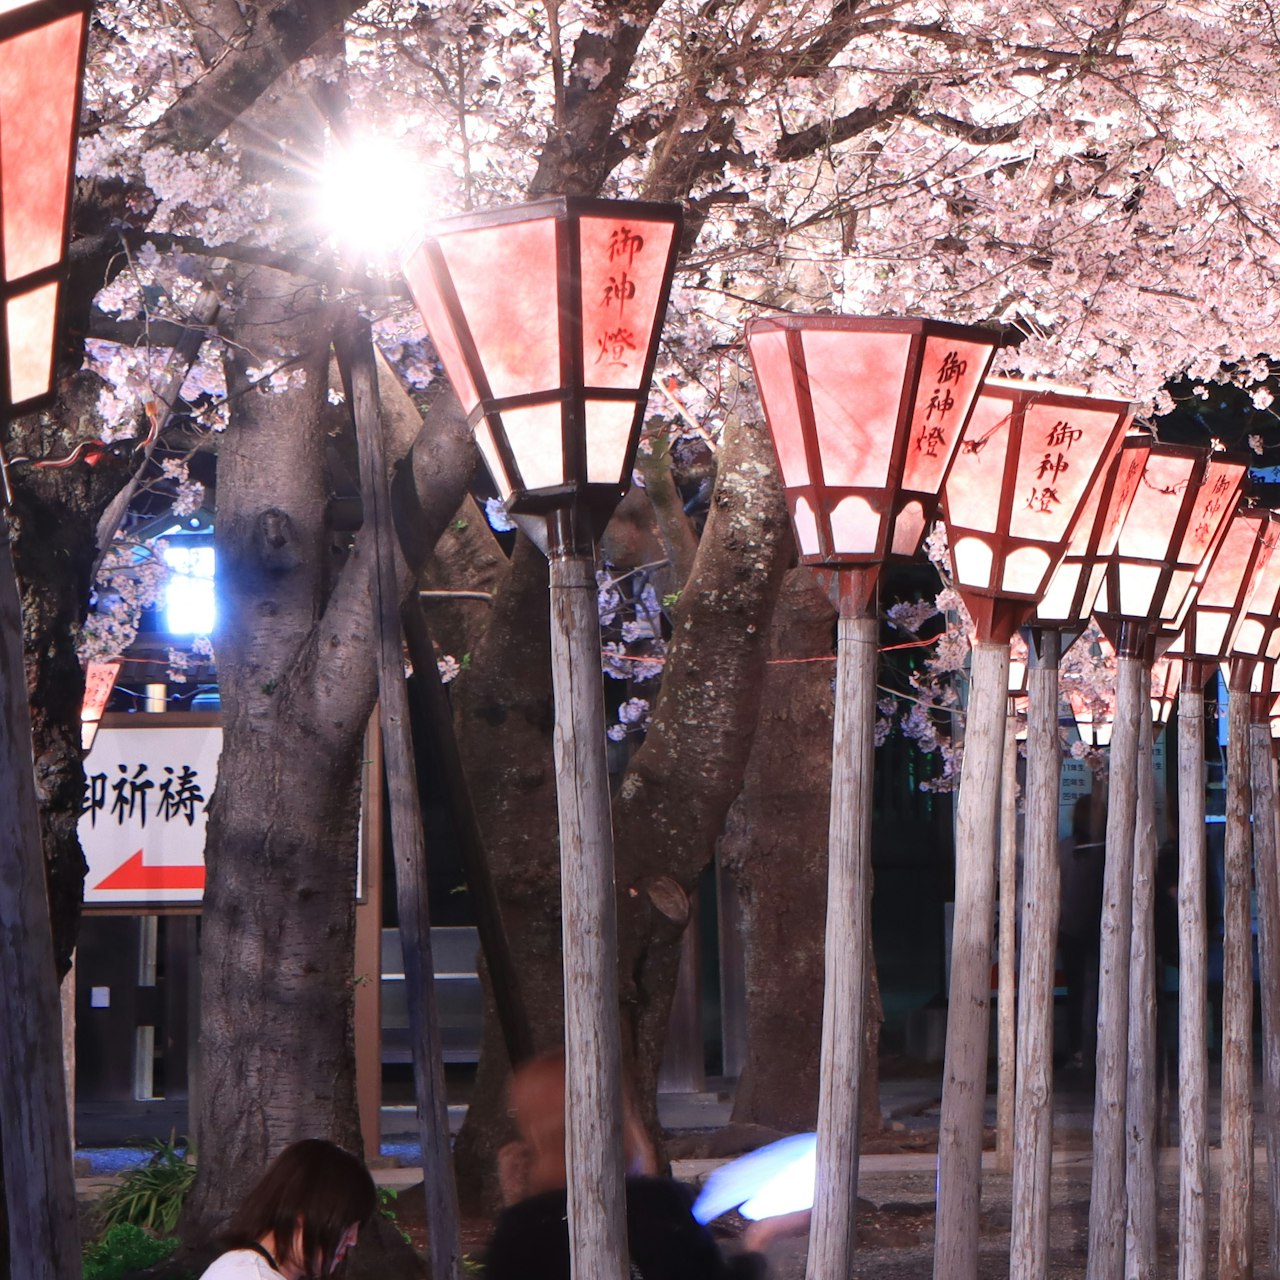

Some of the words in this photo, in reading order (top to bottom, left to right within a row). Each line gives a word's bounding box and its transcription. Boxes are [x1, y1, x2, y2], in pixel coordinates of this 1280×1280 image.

[595, 227, 644, 368] 御神燈
[914, 351, 967, 458] 御神燈
[1025, 420, 1083, 515] 御神燈
[82, 763, 208, 830] 御祈祷
